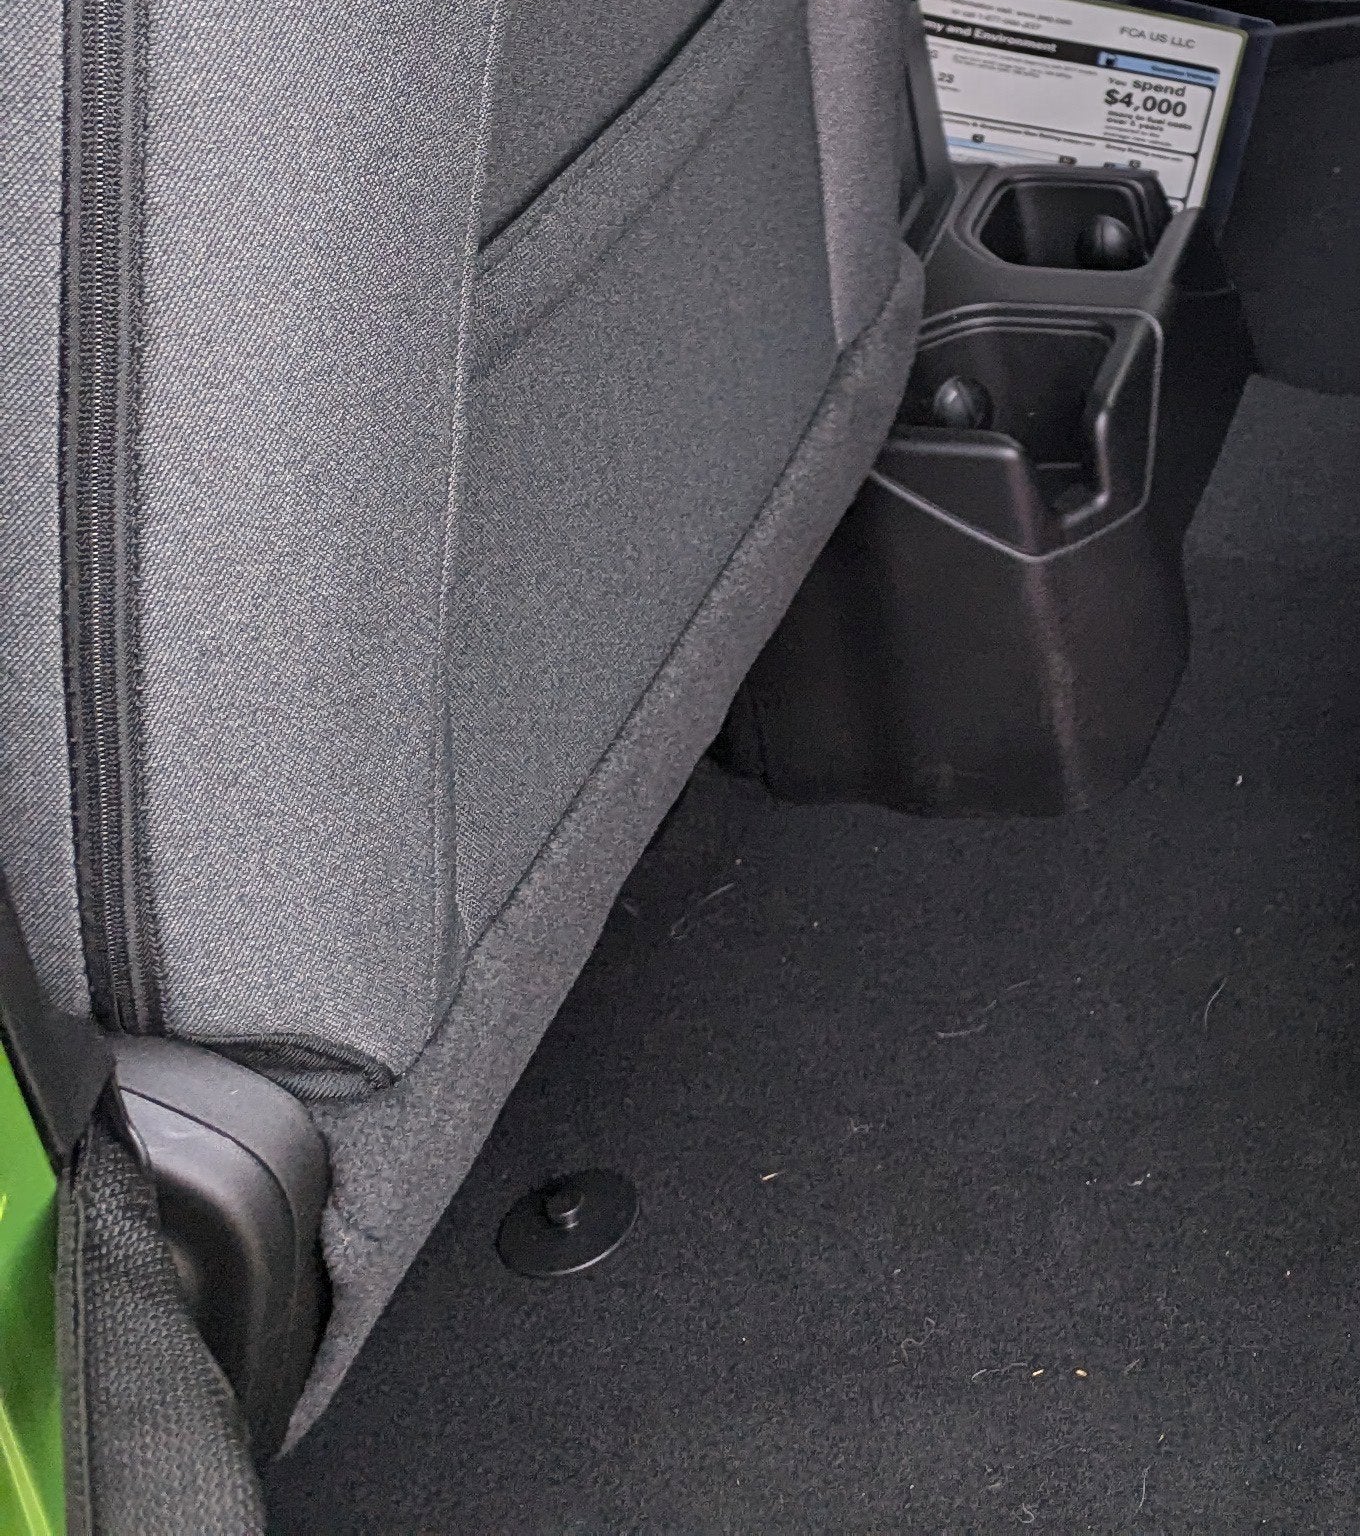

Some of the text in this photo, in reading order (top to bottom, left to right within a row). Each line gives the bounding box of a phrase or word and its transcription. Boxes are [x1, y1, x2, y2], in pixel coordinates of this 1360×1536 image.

[1120, 26, 1196, 49] FCA US LLC
[1132, 79, 1186, 98] spend
[1104, 88, 1187, 117] $4,000
